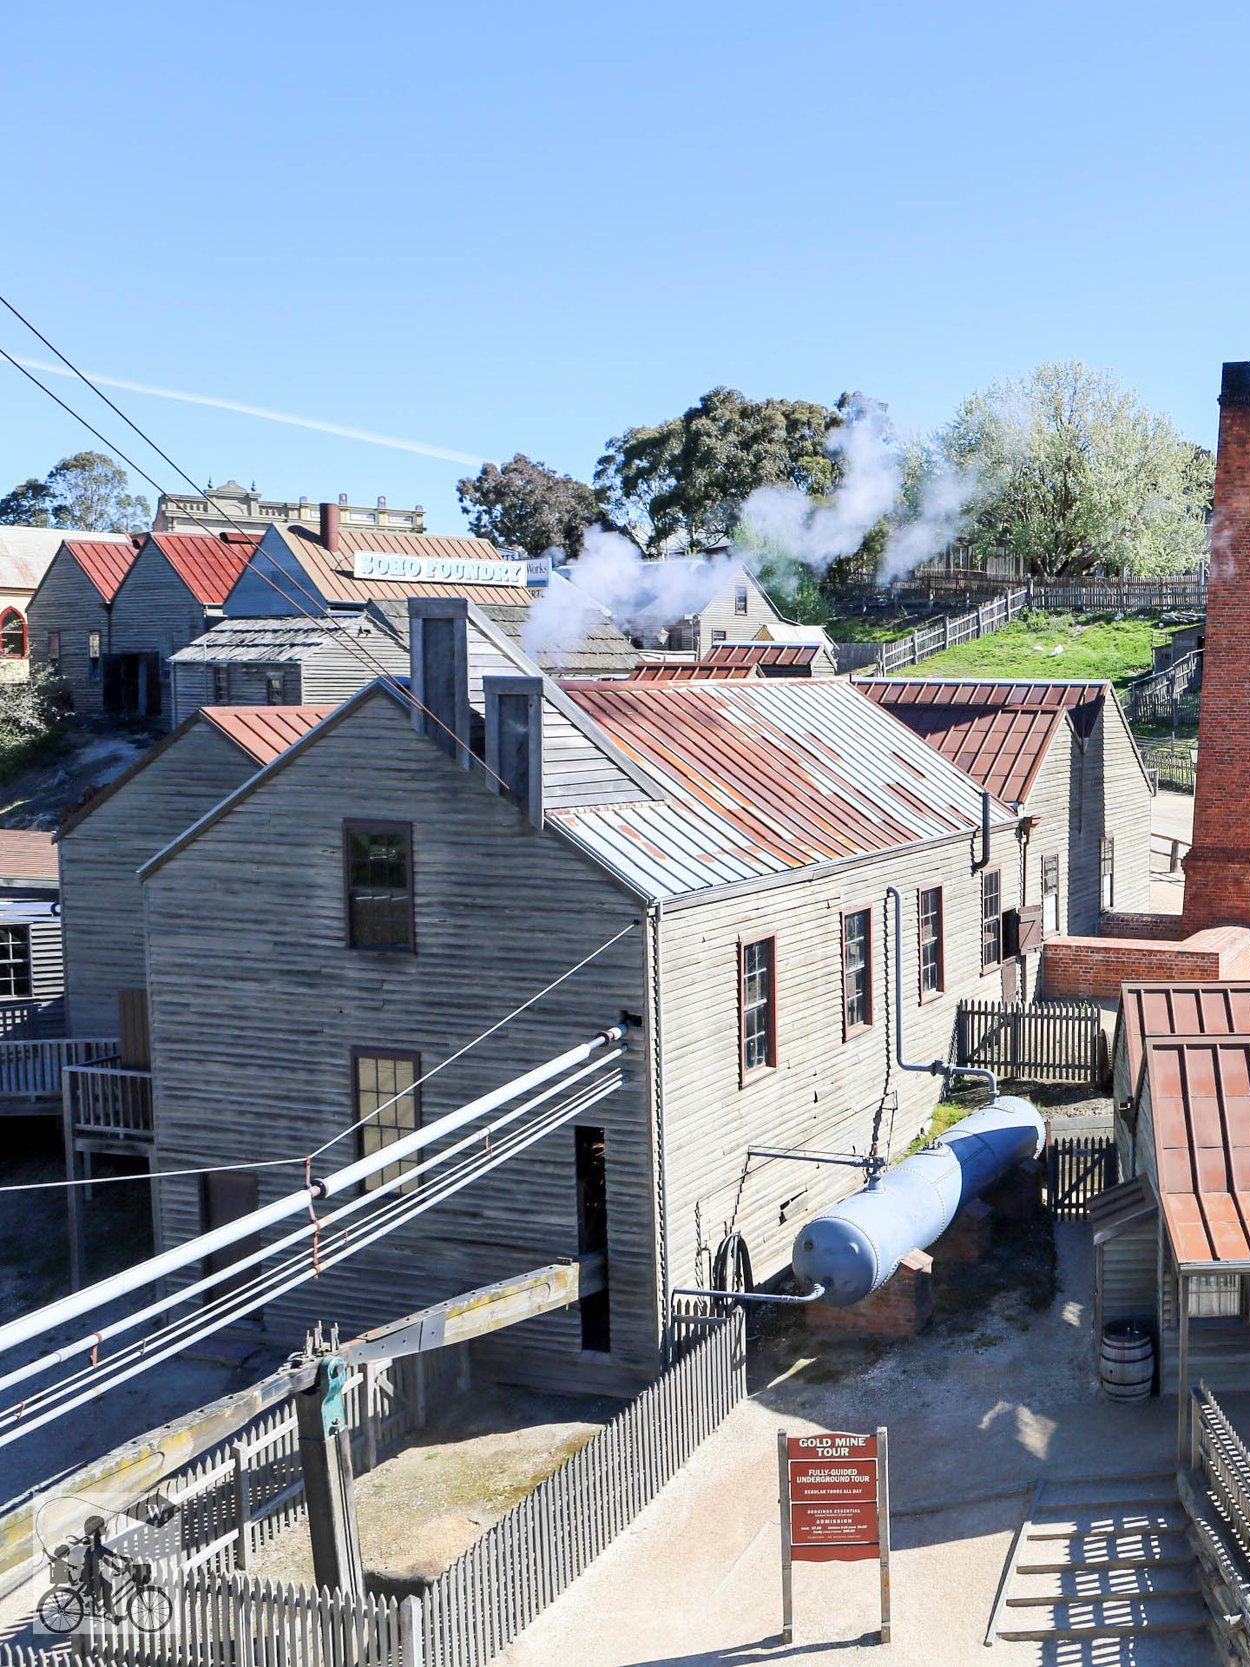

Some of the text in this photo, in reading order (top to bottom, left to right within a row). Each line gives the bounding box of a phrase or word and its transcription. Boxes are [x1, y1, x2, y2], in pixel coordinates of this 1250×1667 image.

[361, 554, 522, 583] SOHO FOUNDRY
[798, 1437, 867, 1448] GOLD MINE
[816, 1447, 850, 1457] TOUR
[808, 1468, 858, 1476] FULLY-GUIDED
[796, 1475, 870, 1484] UNDERGROUND TOUR
